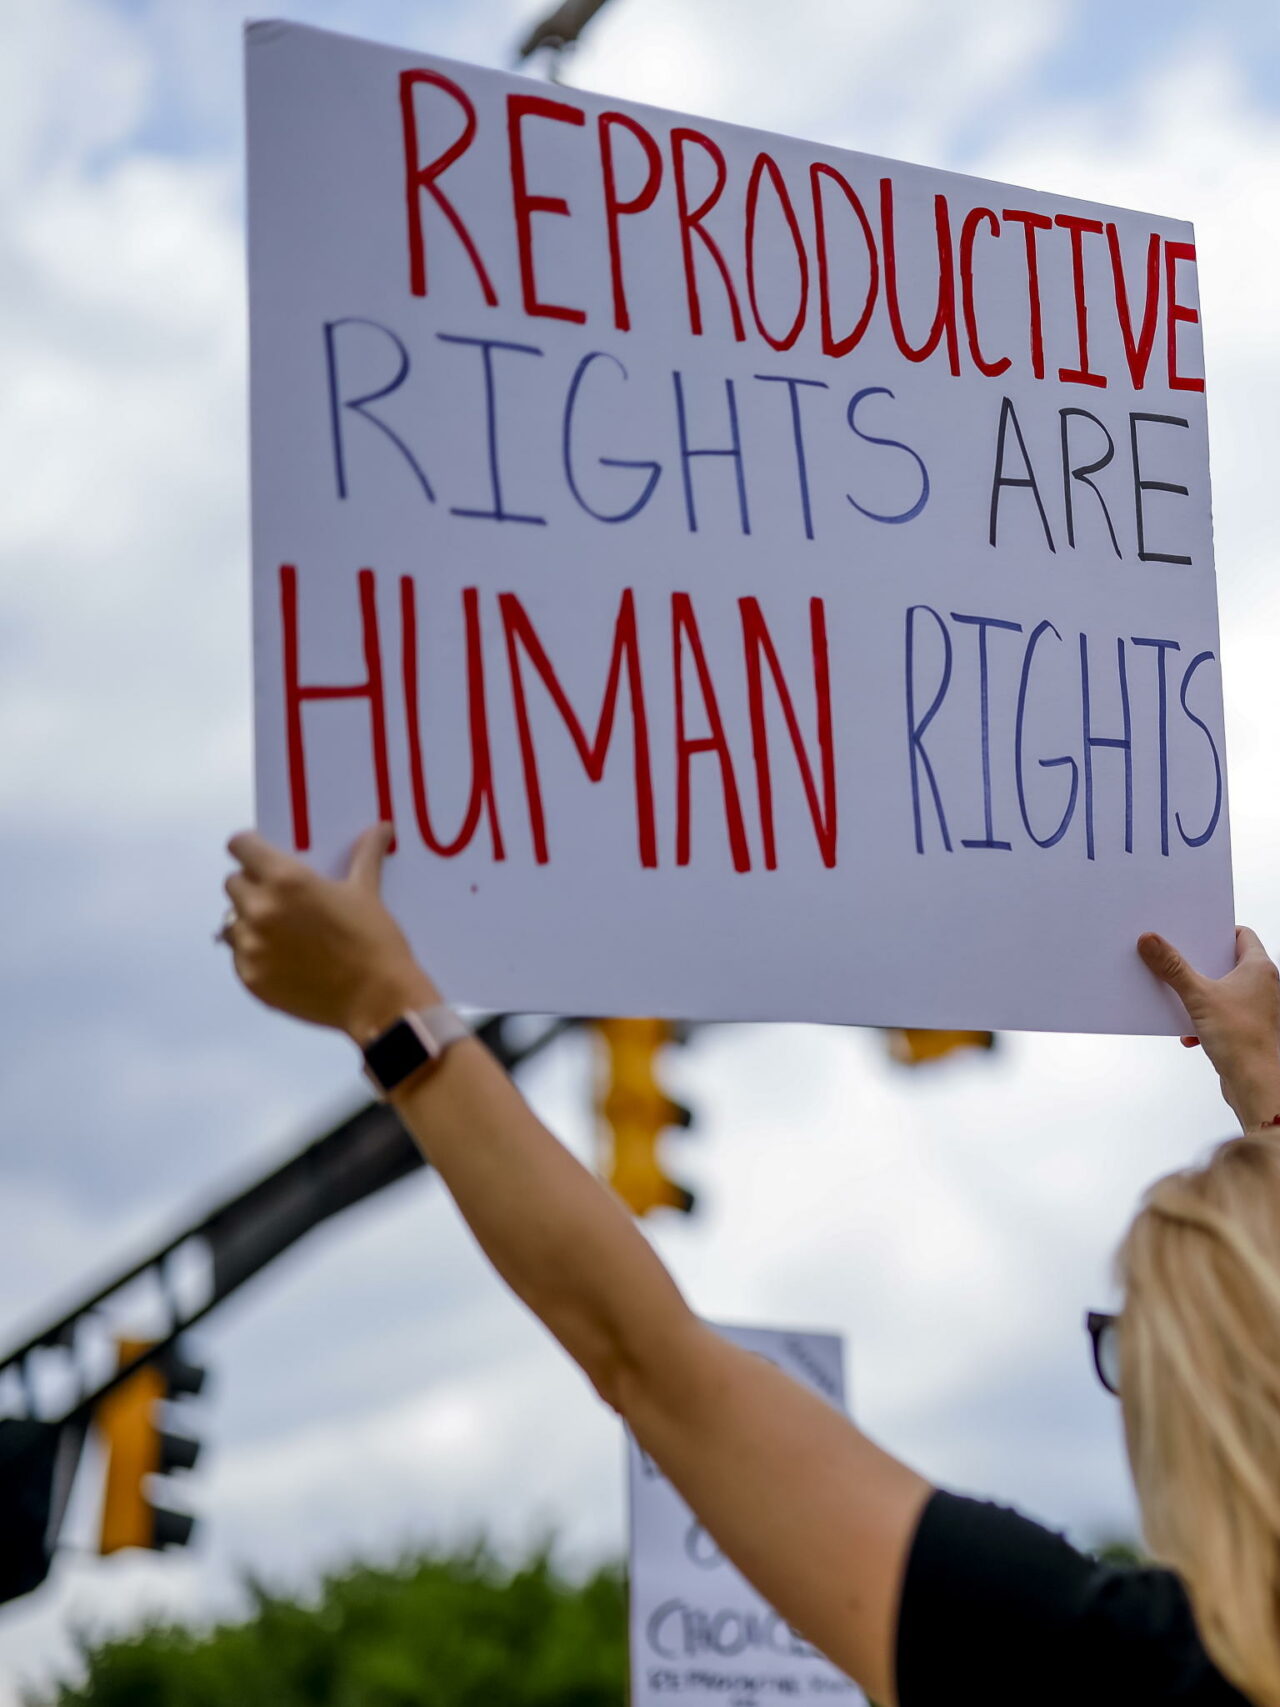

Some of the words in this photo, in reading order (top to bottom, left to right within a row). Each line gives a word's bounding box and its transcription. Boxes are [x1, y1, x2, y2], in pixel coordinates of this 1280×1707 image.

[399, 67, 1206, 393] REPRODUCTIVE
[323, 316, 931, 541] RIGHTS
[988, 396, 1194, 567] ARE
[279, 563, 838, 874] HUMAN
[904, 604, 1223, 861] RIGHTS
